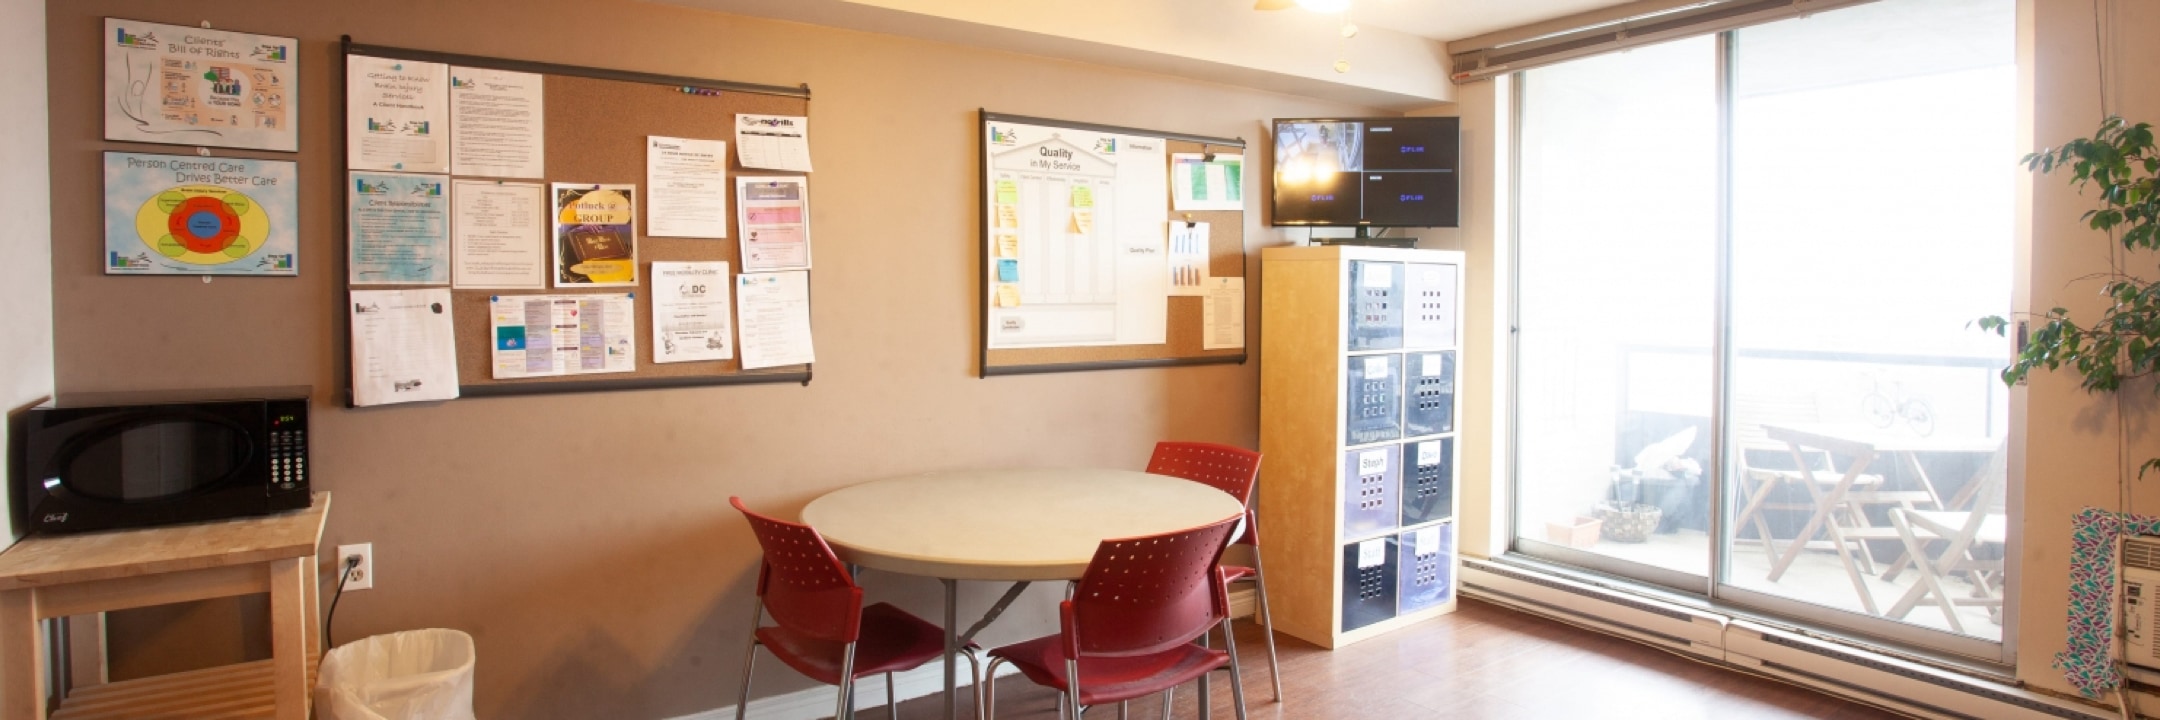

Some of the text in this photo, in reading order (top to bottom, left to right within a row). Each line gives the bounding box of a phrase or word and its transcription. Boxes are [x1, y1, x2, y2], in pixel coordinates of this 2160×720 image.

[168, 44, 240, 59] Bill of Rights
[1040, 146, 1074, 161] Quality
[127, 157, 245, 173] Person Centred Care
[1039, 160, 1051, 170] My
[1053, 161, 1081, 171] Service
[176, 172, 278, 186] Drives Better Care
[569, 202, 605, 210] Potluck
[573, 213, 615, 223] GROUP
